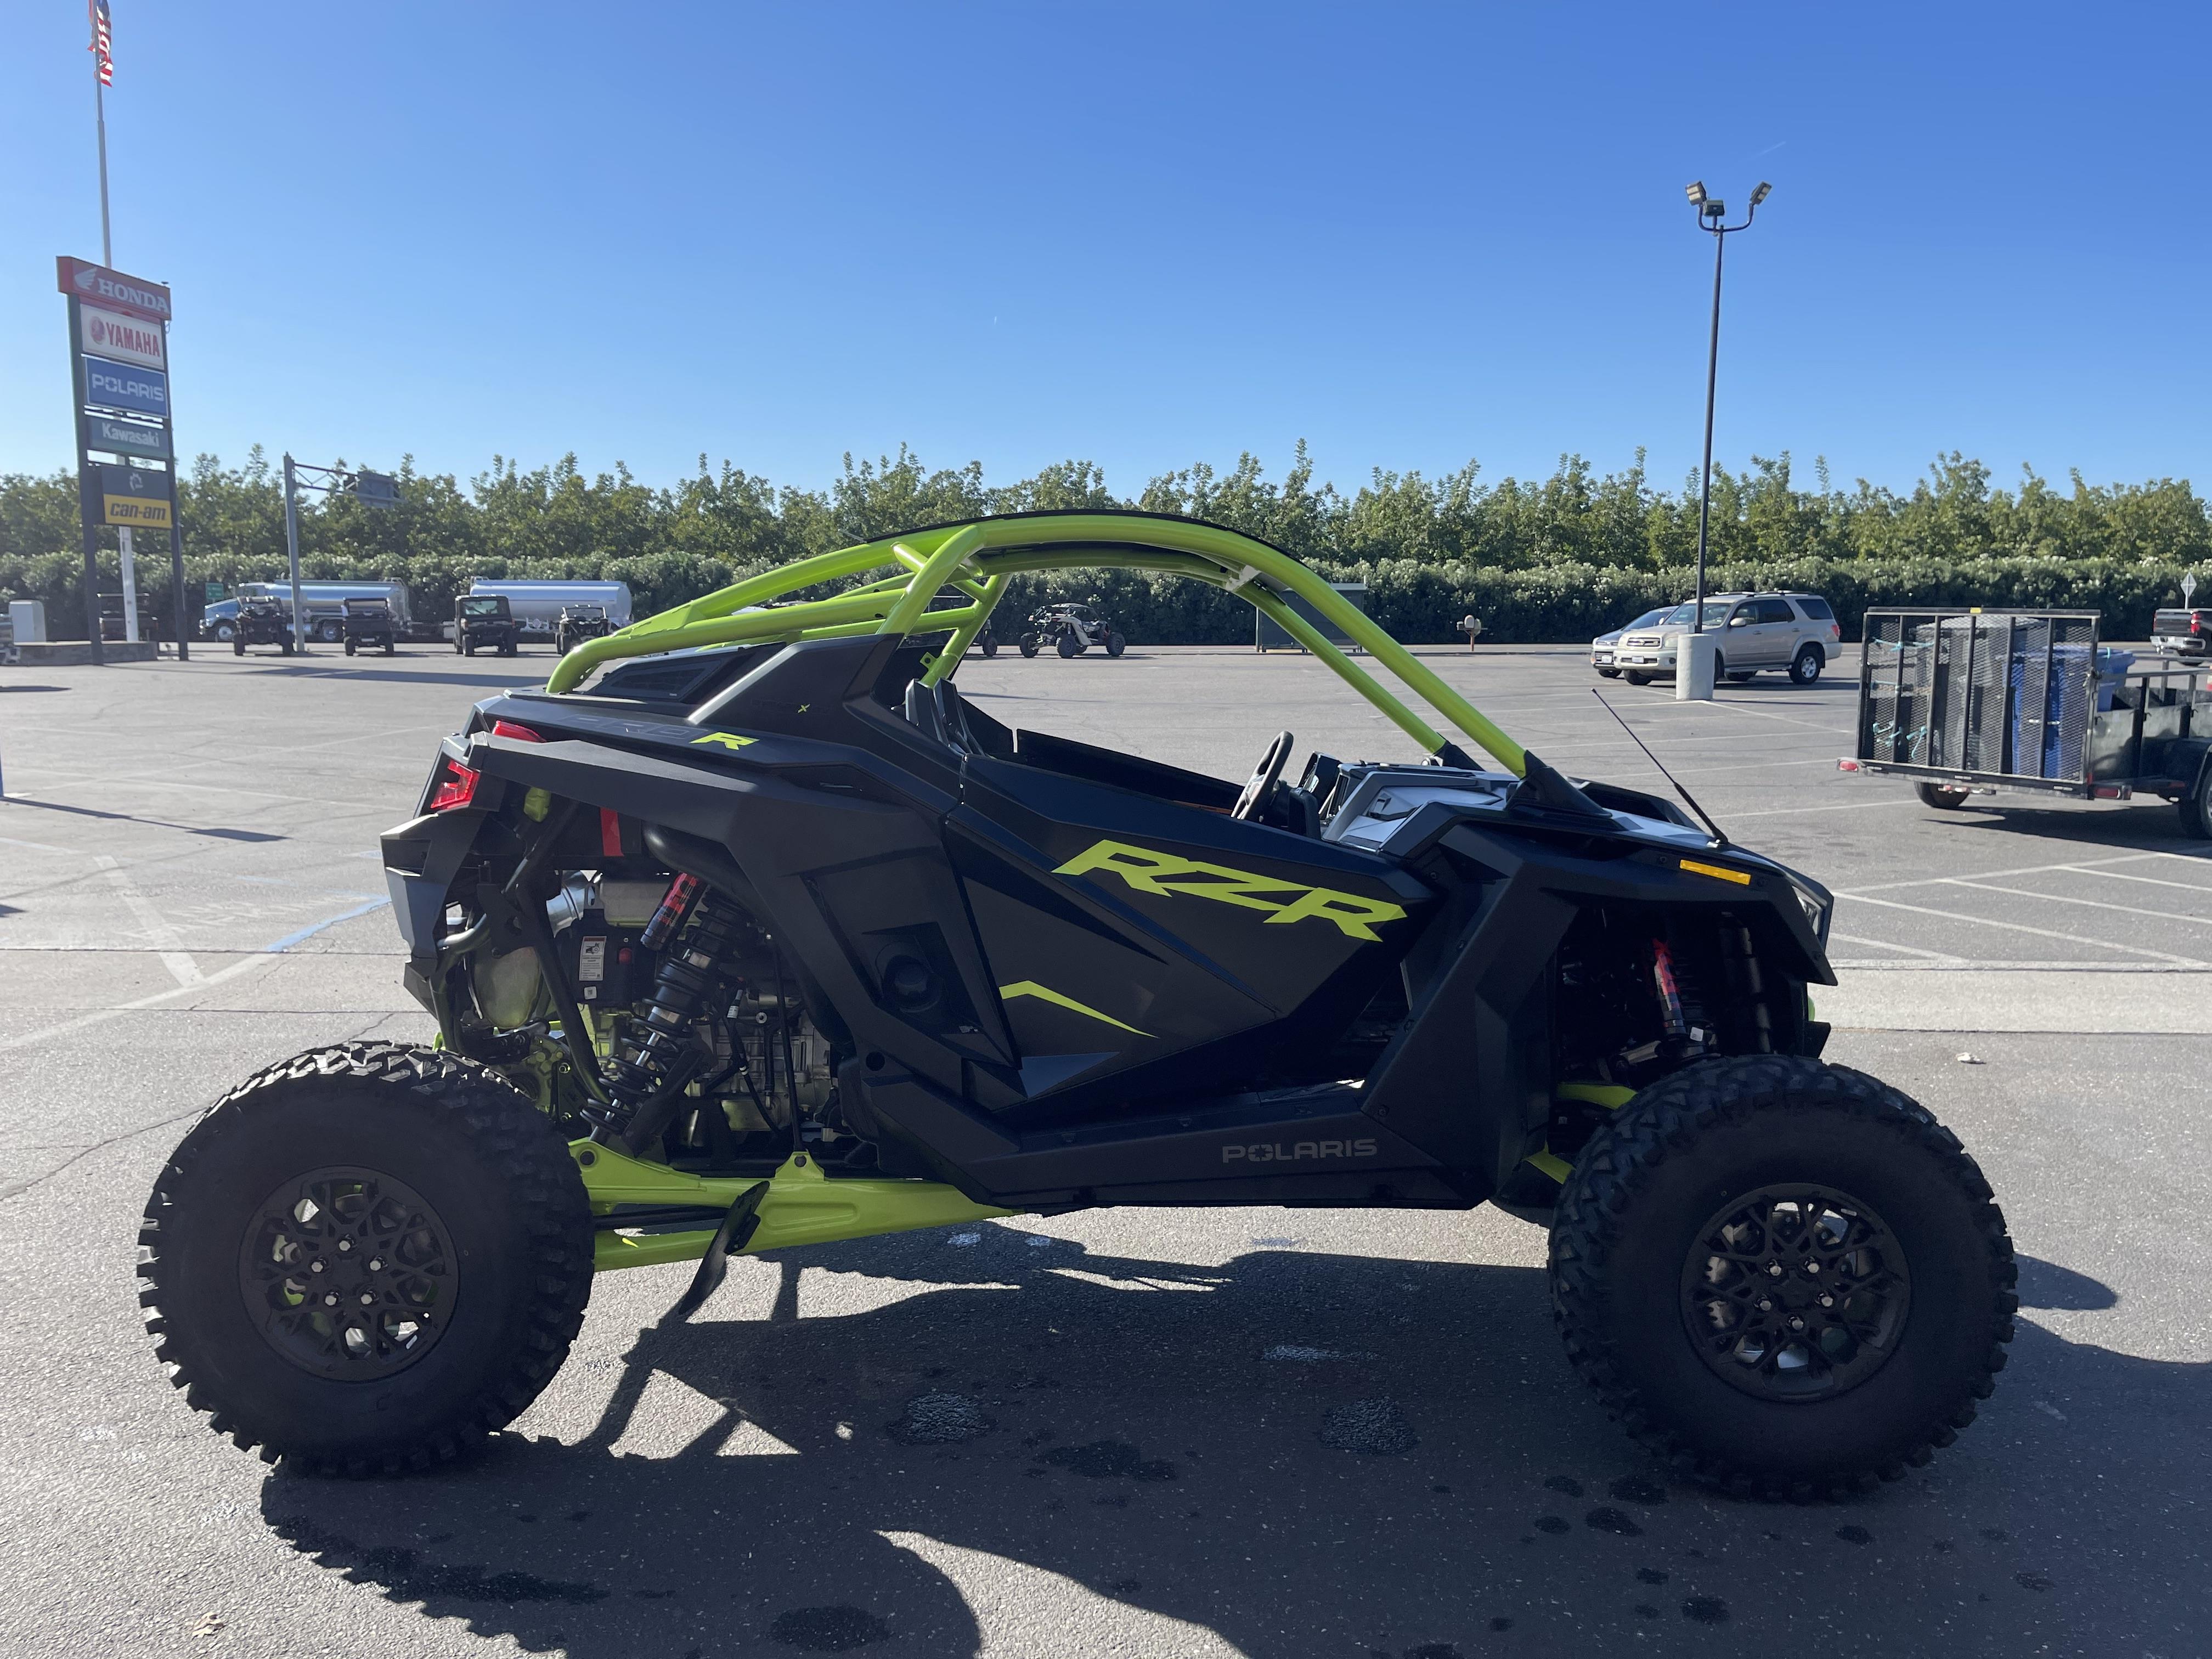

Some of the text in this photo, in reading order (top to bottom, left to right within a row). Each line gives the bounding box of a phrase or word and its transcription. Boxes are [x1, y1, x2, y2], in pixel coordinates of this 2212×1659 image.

[97, 278, 168, 312] HONDA
[106, 321, 160, 357] YAMAHA
[92, 373, 164, 401] POLARIS
[101, 422, 160, 447] Kawasaki
[110, 503, 166, 521] can-am
[689, 732, 760, 751] R
[1051, 839, 1408, 942] RZR
[1222, 1138, 1378, 1164] POLARIS
